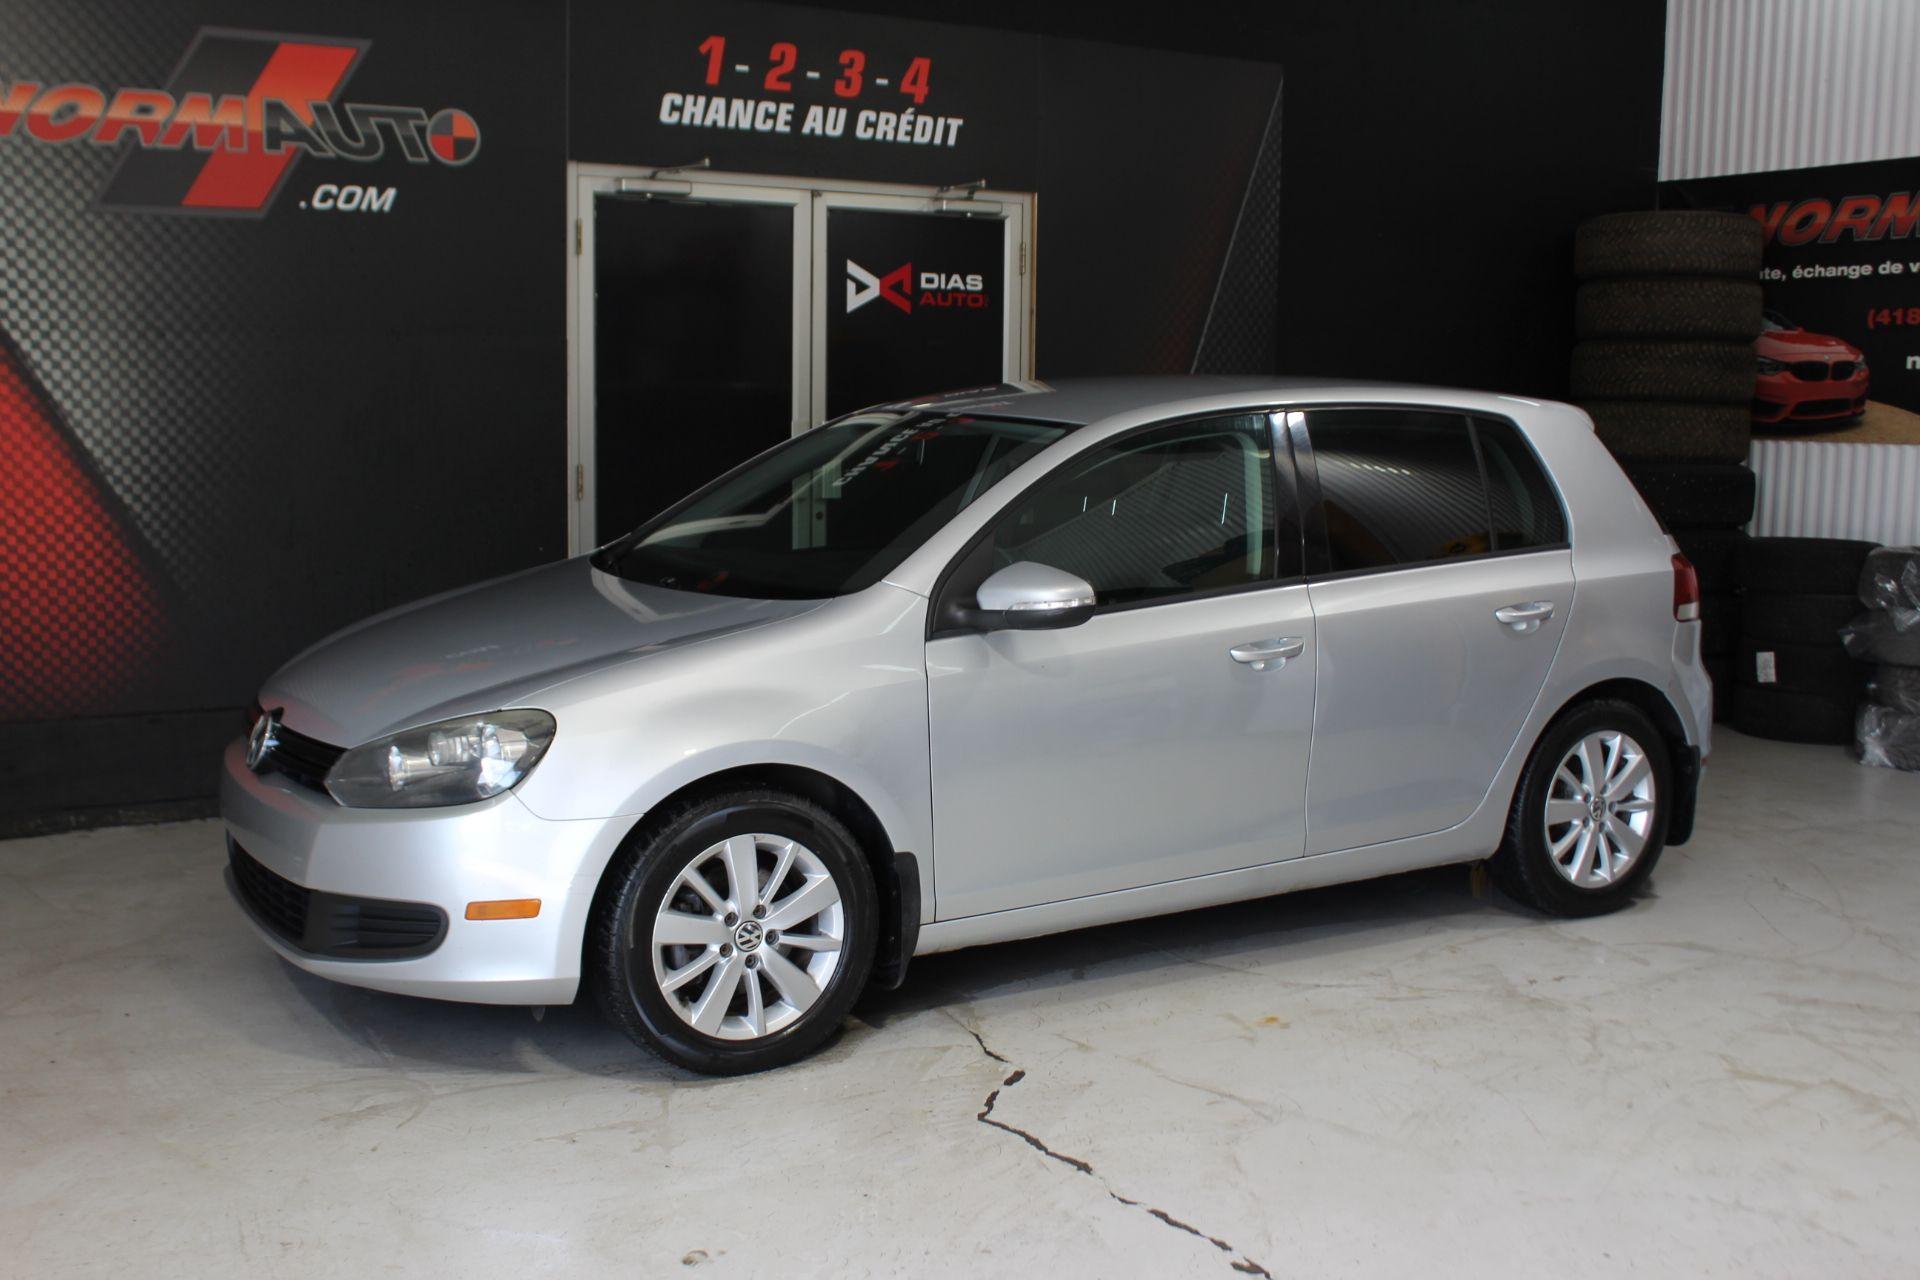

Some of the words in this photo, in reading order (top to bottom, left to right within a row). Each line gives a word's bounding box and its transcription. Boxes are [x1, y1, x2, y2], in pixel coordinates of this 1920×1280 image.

[698, 35, 726, 86] 1
[764, 42, 798, 92] 2
[834, 49, 866, 98] 3
[900, 57, 932, 104] 4
[659, 92, 795, 133] CHANCE
[801, 105, 847, 138] AU
[855, 107, 964, 147] CRÉDIT
[299, 183, 397, 213] .COM
[1792, 264, 1872, 280] échange
[1878, 260, 1904, 275] de
[920, 272, 984, 291] DIAS
[920, 292, 985, 308] AUTO
[1867, 308, 1920, 329] (418
